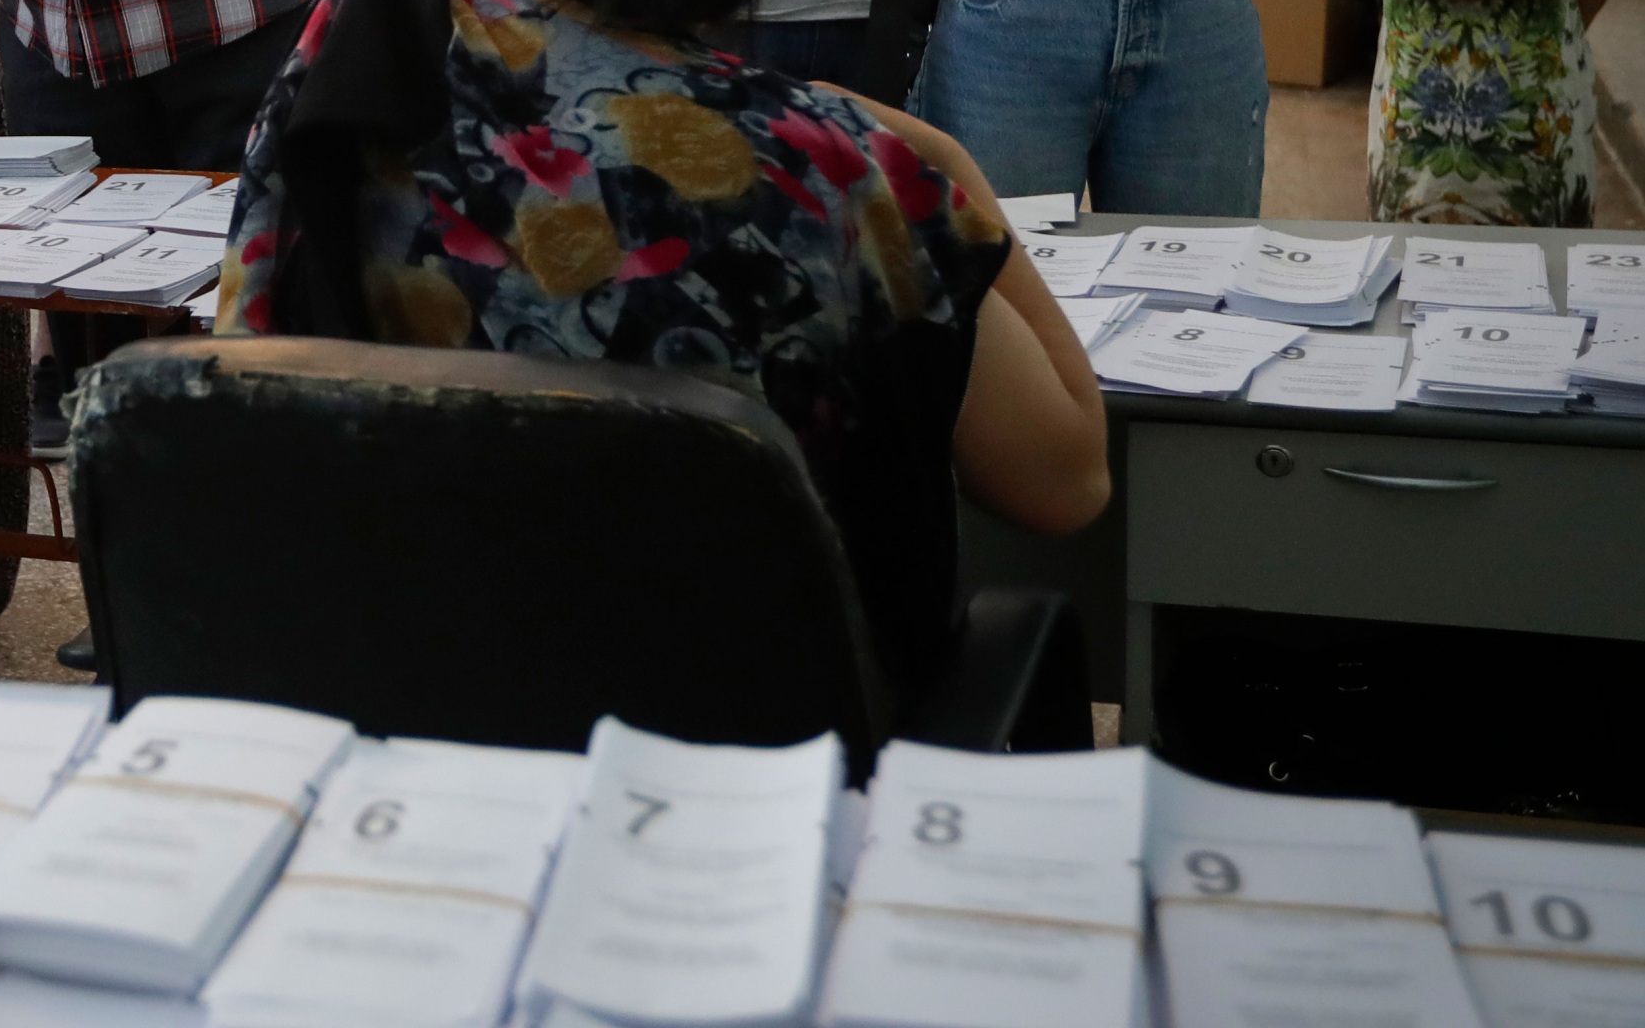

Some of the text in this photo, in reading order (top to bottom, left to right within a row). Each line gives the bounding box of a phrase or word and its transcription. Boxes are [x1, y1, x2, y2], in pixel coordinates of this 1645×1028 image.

[102, 181, 147, 192] 21
[24, 234, 70, 248] 10
[1139, 240, 1188, 253] 19
[137, 247, 180, 260] 11
[1258, 244, 1312, 263] 20
[1415, 252, 1466, 267] 21
[1585, 254, 1642, 268] 23
[1172, 328, 1205, 341] 8
[1452, 326, 1511, 342] 10
[1278, 345, 1306, 361] 9
[120, 738, 179, 775] 5
[353, 800, 406, 840] 6
[625, 790, 671, 836] 7
[912, 801, 965, 848] 8
[1183, 849, 1242, 898] 9
[1470, 889, 1594, 944] 10
